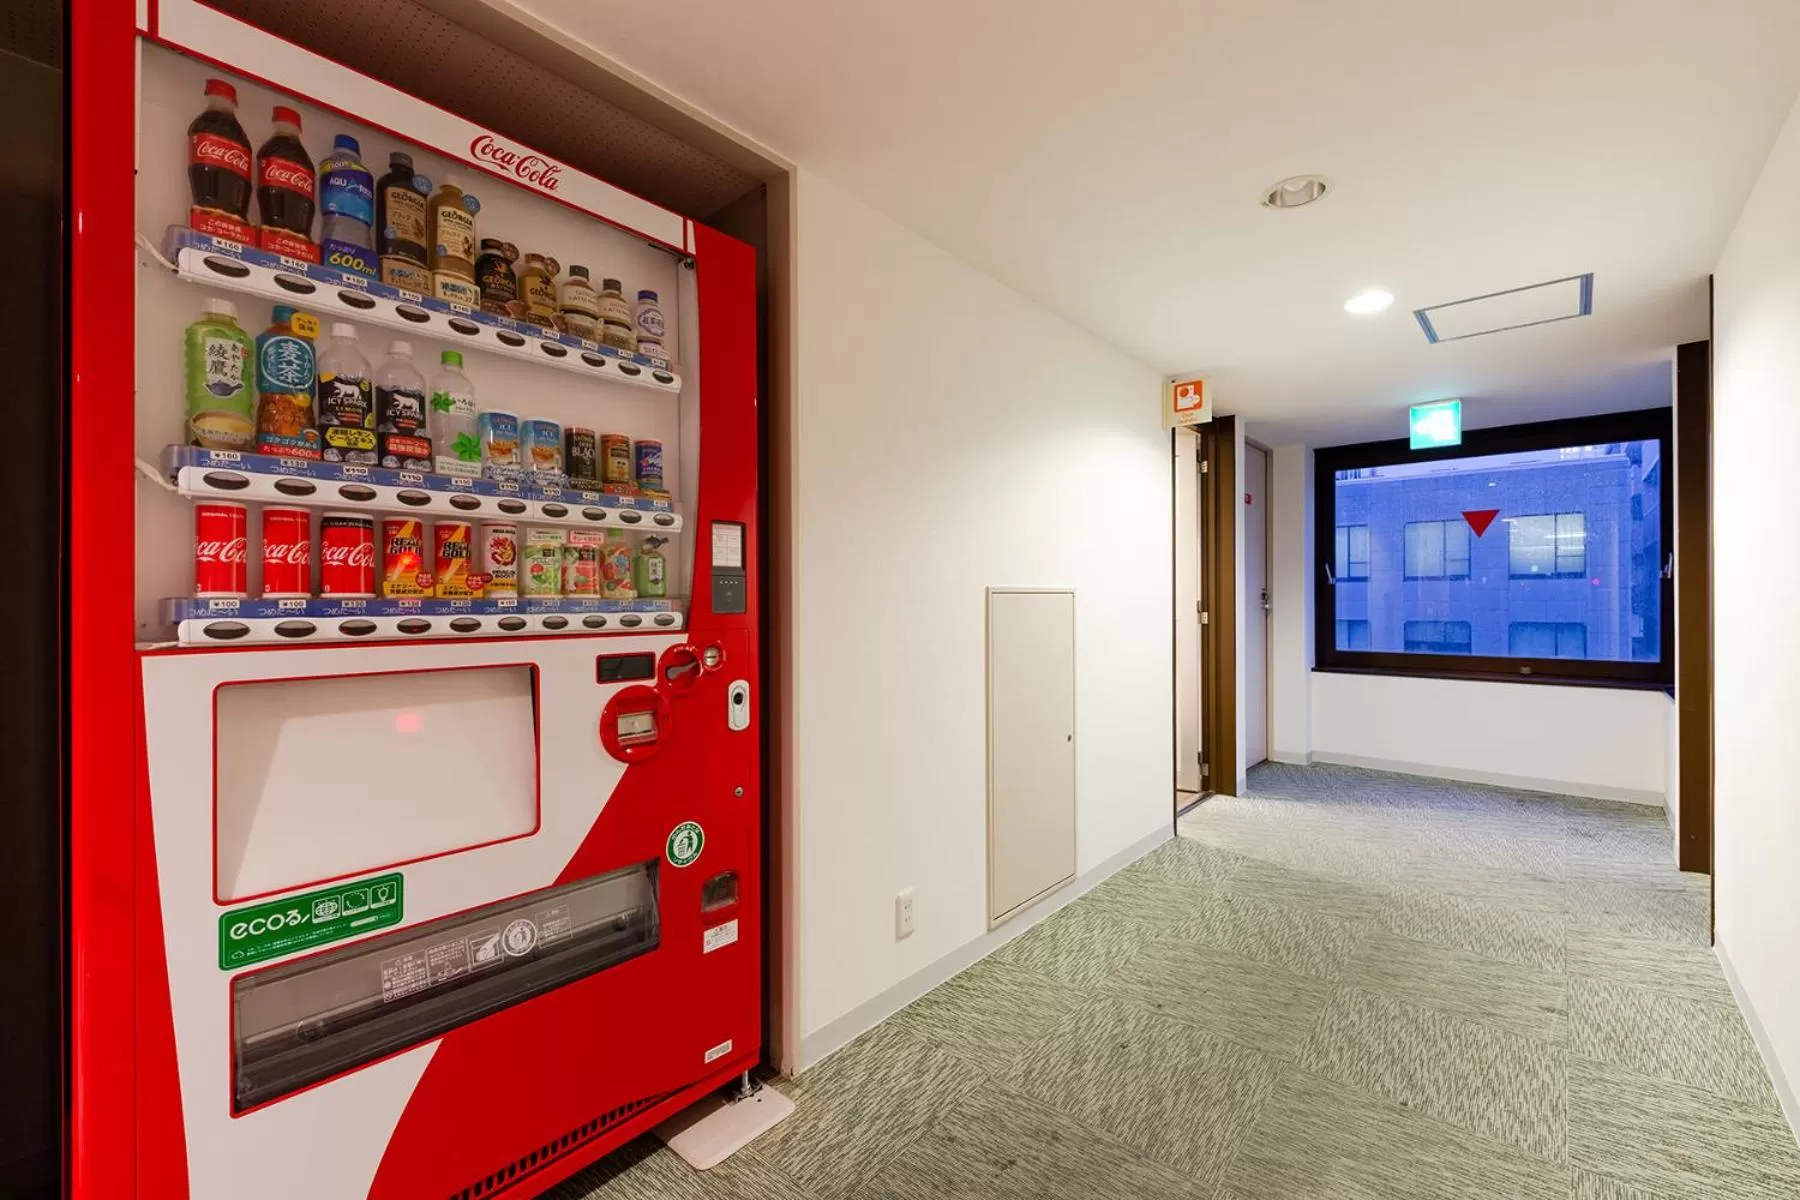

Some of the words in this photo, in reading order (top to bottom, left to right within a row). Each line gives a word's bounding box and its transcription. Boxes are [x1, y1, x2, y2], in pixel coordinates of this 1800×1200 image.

[197, 141, 249, 171] Coca-Cola
[470, 135, 564, 190] Coca-Cola
[265, 164, 313, 191] Coca-Cola
[329, 252, 376, 276] 600ml
[207, 343, 230, 378] 綾鷹
[278, 341, 302, 383] 麦茶
[442, 549, 471, 559] GOLD
[282, 600, 304, 608] ¥100
